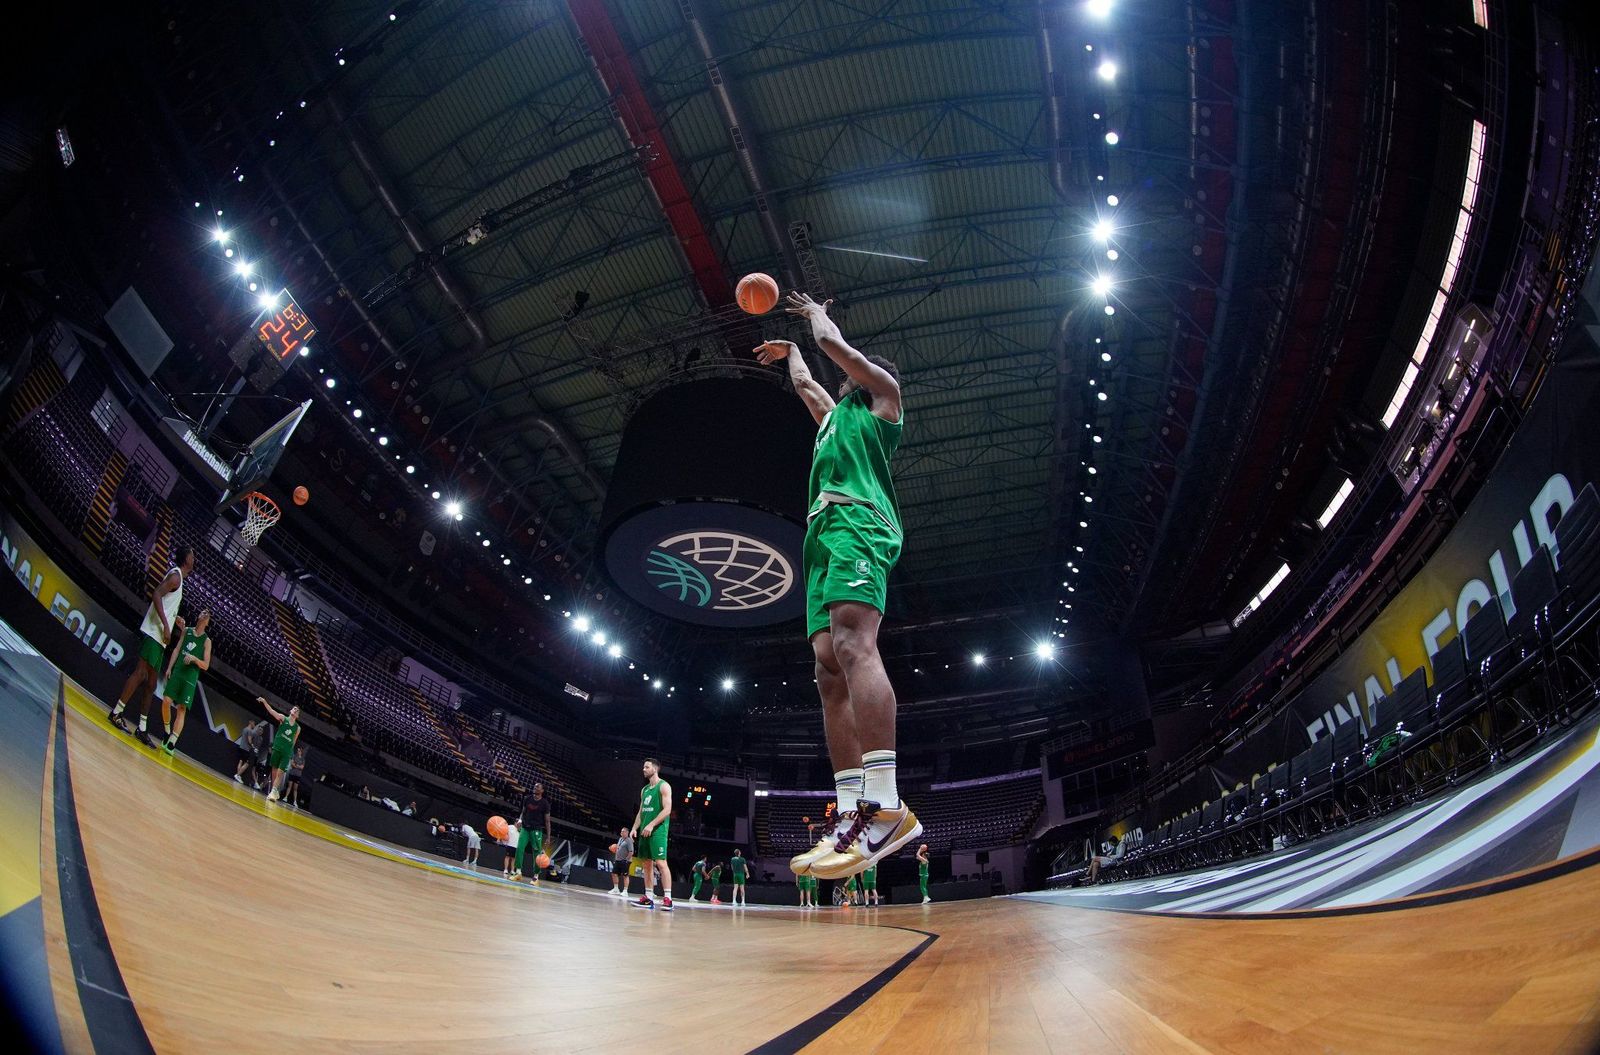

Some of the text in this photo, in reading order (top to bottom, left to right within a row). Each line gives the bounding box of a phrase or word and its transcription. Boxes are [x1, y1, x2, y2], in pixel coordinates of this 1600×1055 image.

[259, 313, 299, 358] 24
[183, 429, 231, 482] #BasketballCL
[50, 592, 126, 668] FOUR
